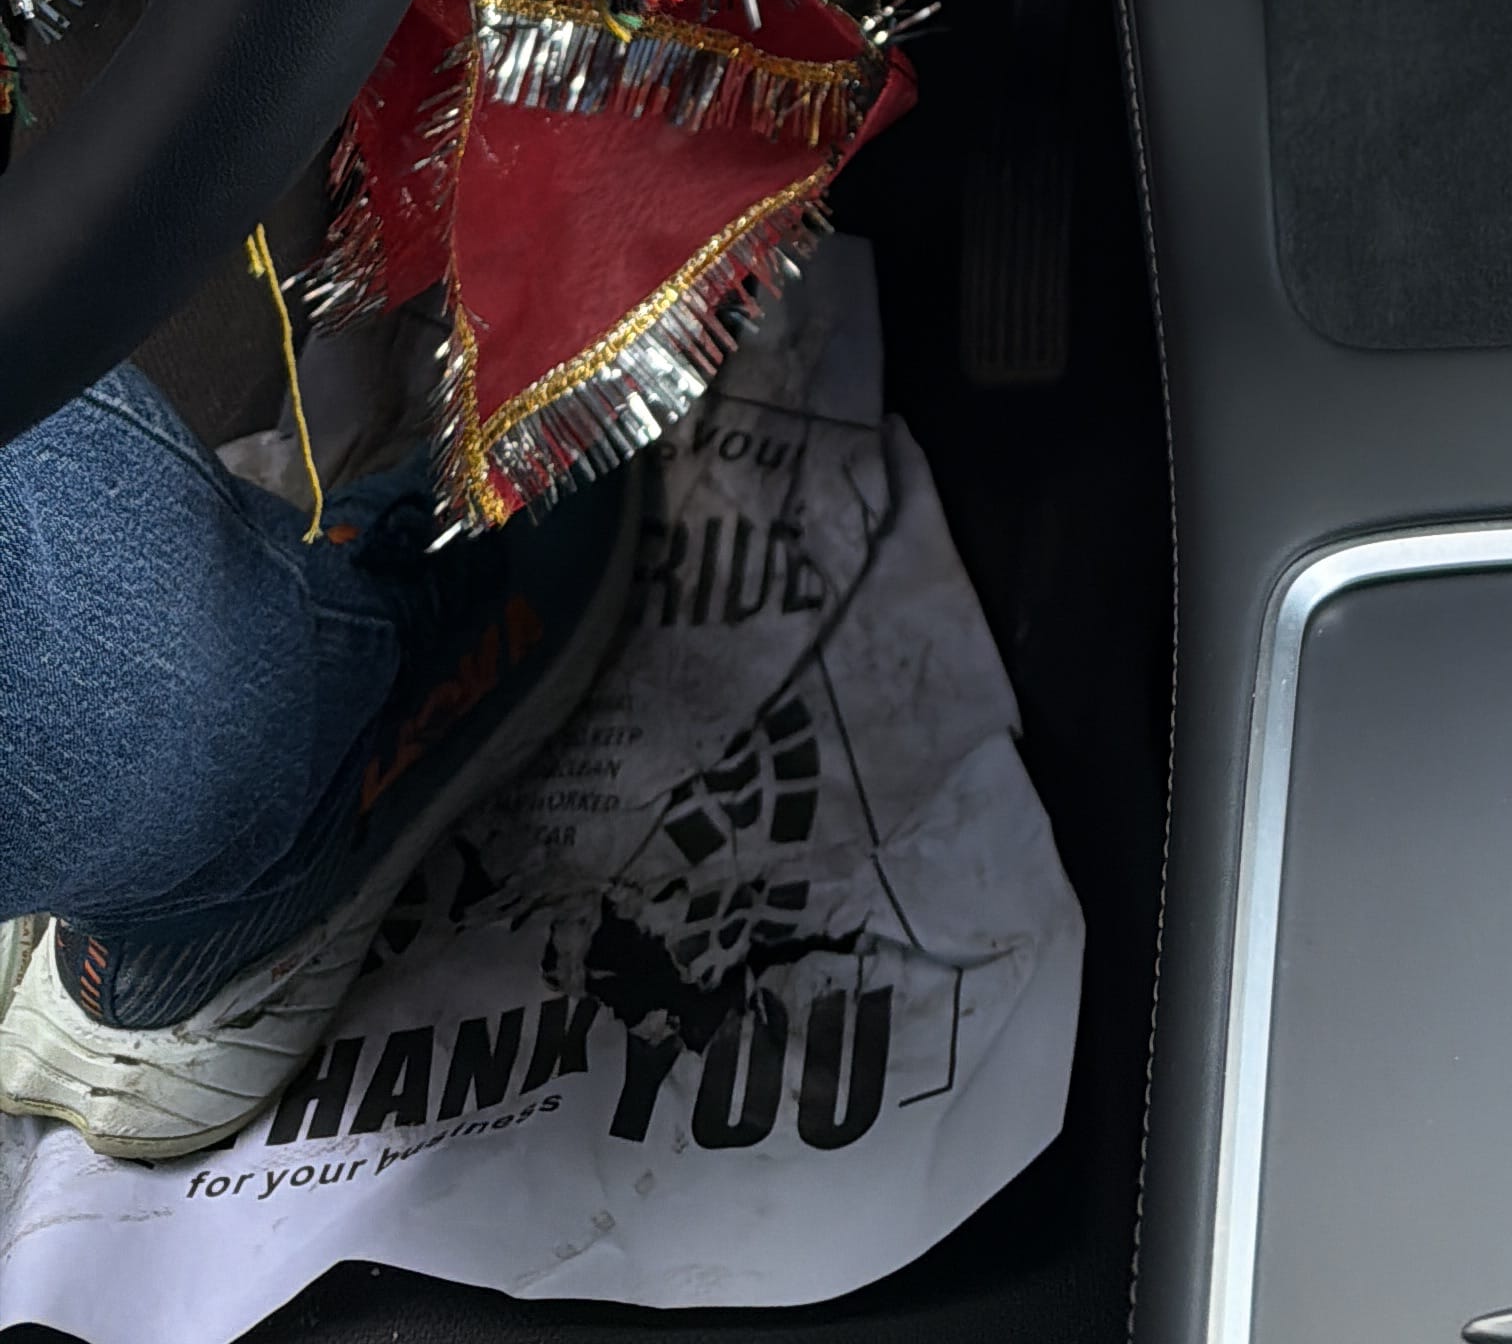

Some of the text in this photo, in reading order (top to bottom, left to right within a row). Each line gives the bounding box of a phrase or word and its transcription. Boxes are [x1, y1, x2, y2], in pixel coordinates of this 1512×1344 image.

[240, 983, 893, 1150] HANK YOU
[186, 1093, 561, 1200] for your business
